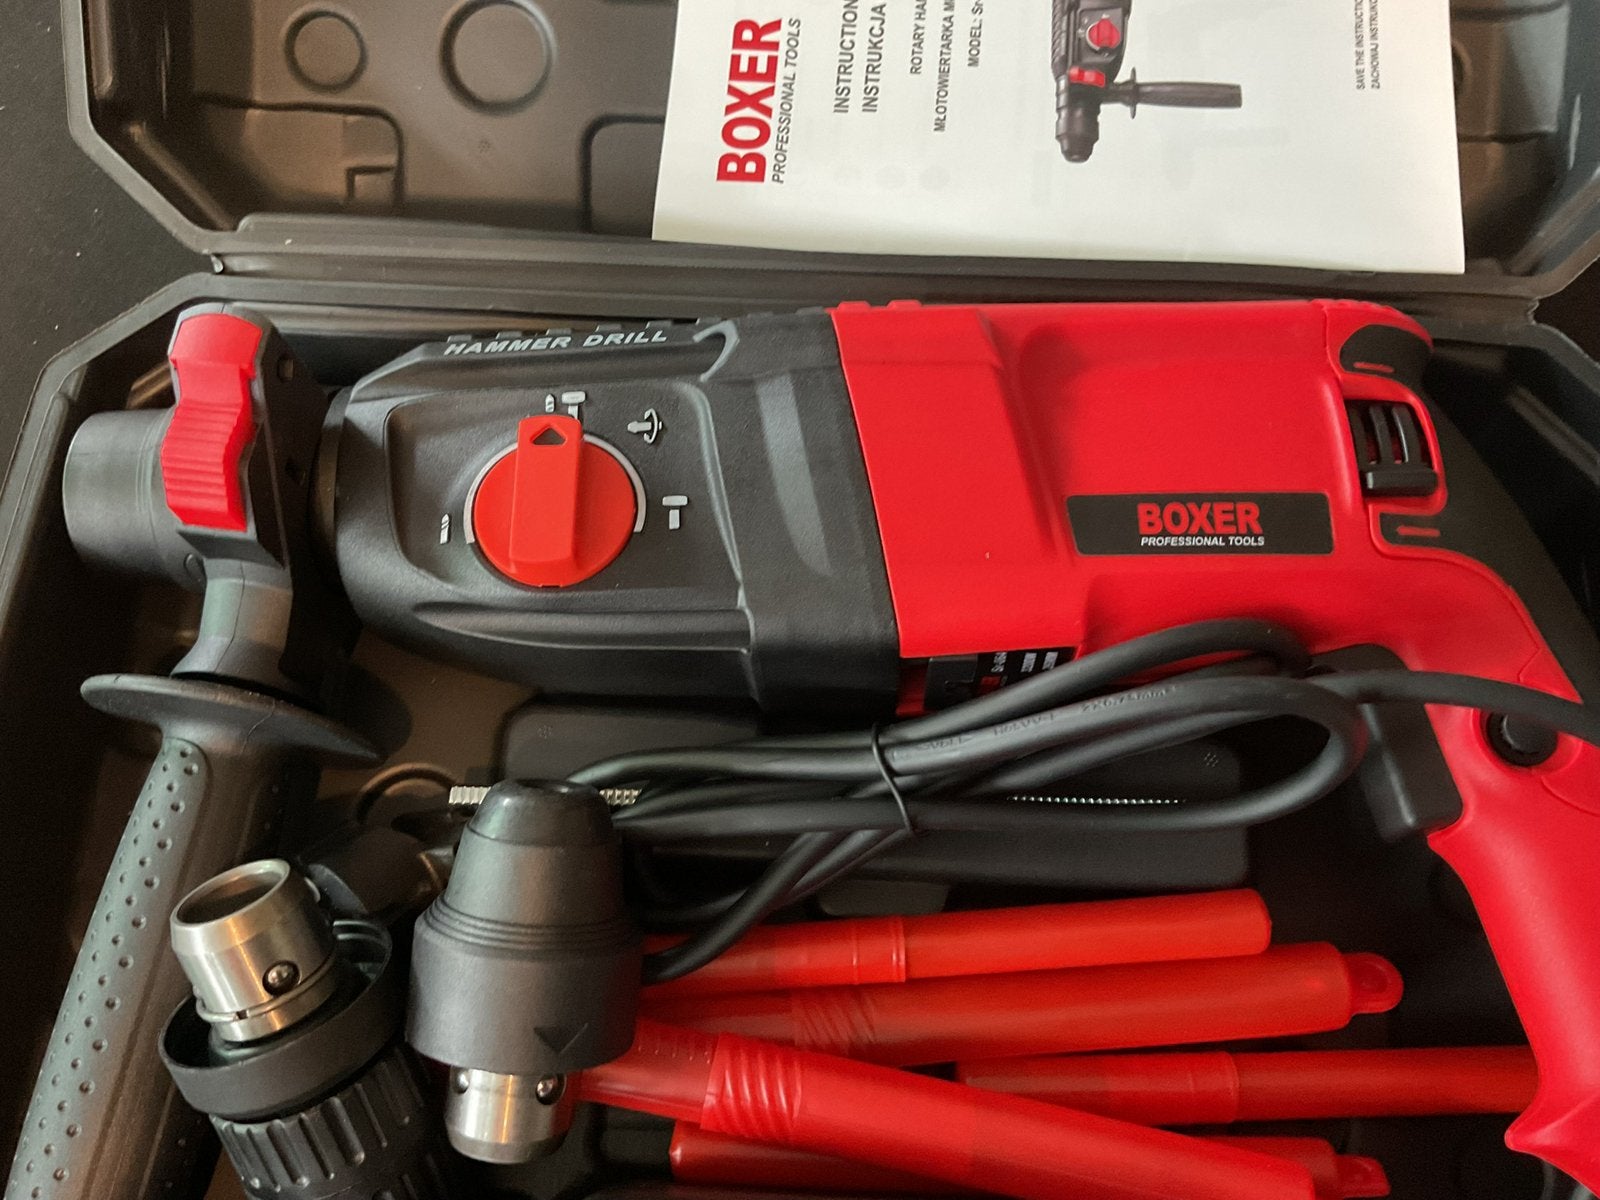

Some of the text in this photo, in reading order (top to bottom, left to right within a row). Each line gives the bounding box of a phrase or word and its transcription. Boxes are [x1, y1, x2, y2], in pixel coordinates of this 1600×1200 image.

[833, 0, 858, 113] INSTRUCTION
[861, 3, 887, 113] INSTRUKCJA
[910, 0, 928, 75] ROTARY HA
[967, 18, 983, 68] MODEL:
[1354, 49, 1365, 66] THE
[933, 15, 955, 132] MŁOTOWIERTARKA
[1355, 68, 1366, 90] SAVE
[1369, 42, 1380, 89] ZACHOWAJ
[716, 18, 782, 183] BOXER
[772, 18, 802, 184] PROFESSIONAL TOOLS
[443, 330, 668, 356] HAMMER DRILL
[1137, 501, 1263, 535] BOXER
[1140, 535, 1265, 547] PROFESSIONAL TOOLS
